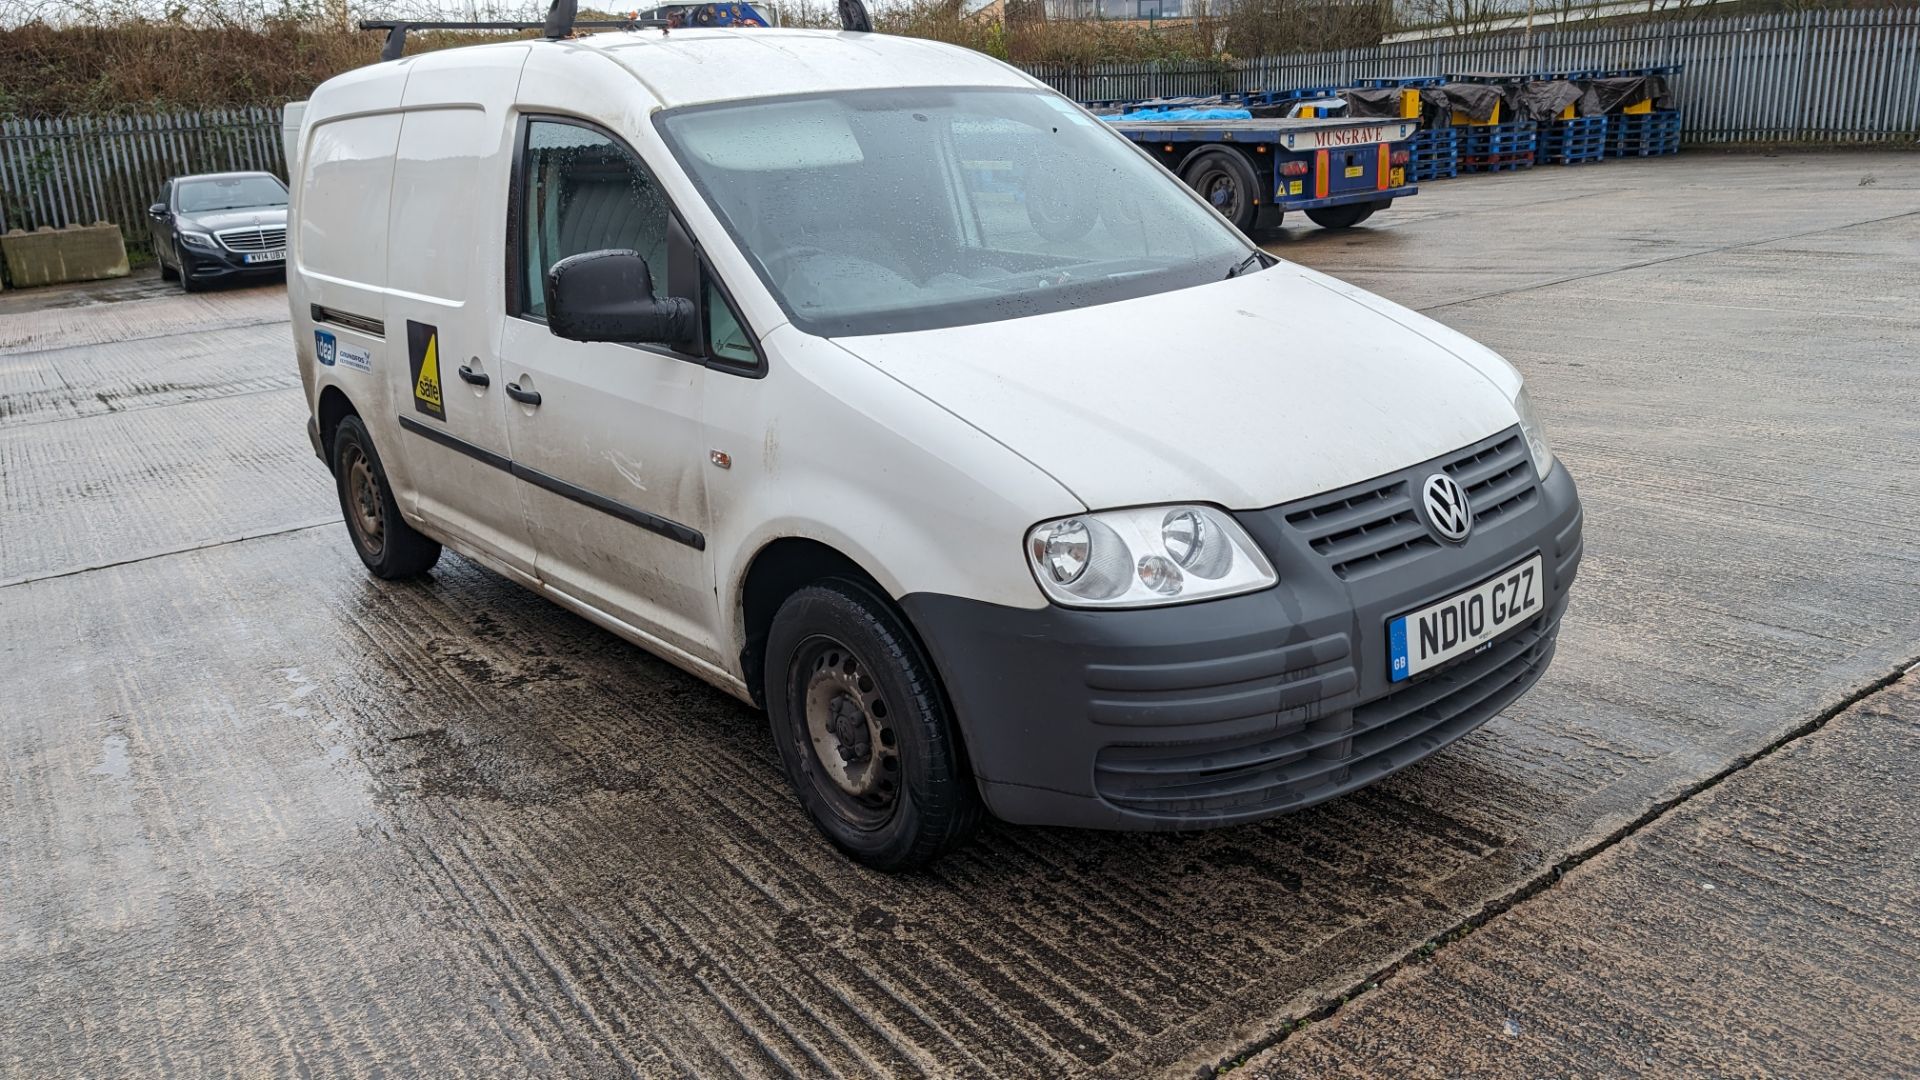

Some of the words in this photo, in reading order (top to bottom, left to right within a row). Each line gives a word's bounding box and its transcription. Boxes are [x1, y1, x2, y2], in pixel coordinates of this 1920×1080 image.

[1314, 127, 1384, 147] MUSGRAVE
[316, 336, 335, 361] ideal
[419, 379, 439, 401] safe
[1419, 593, 1485, 660] ND10
[1492, 566, 1535, 626] GZZ
[1394, 656, 1406, 671] GB
